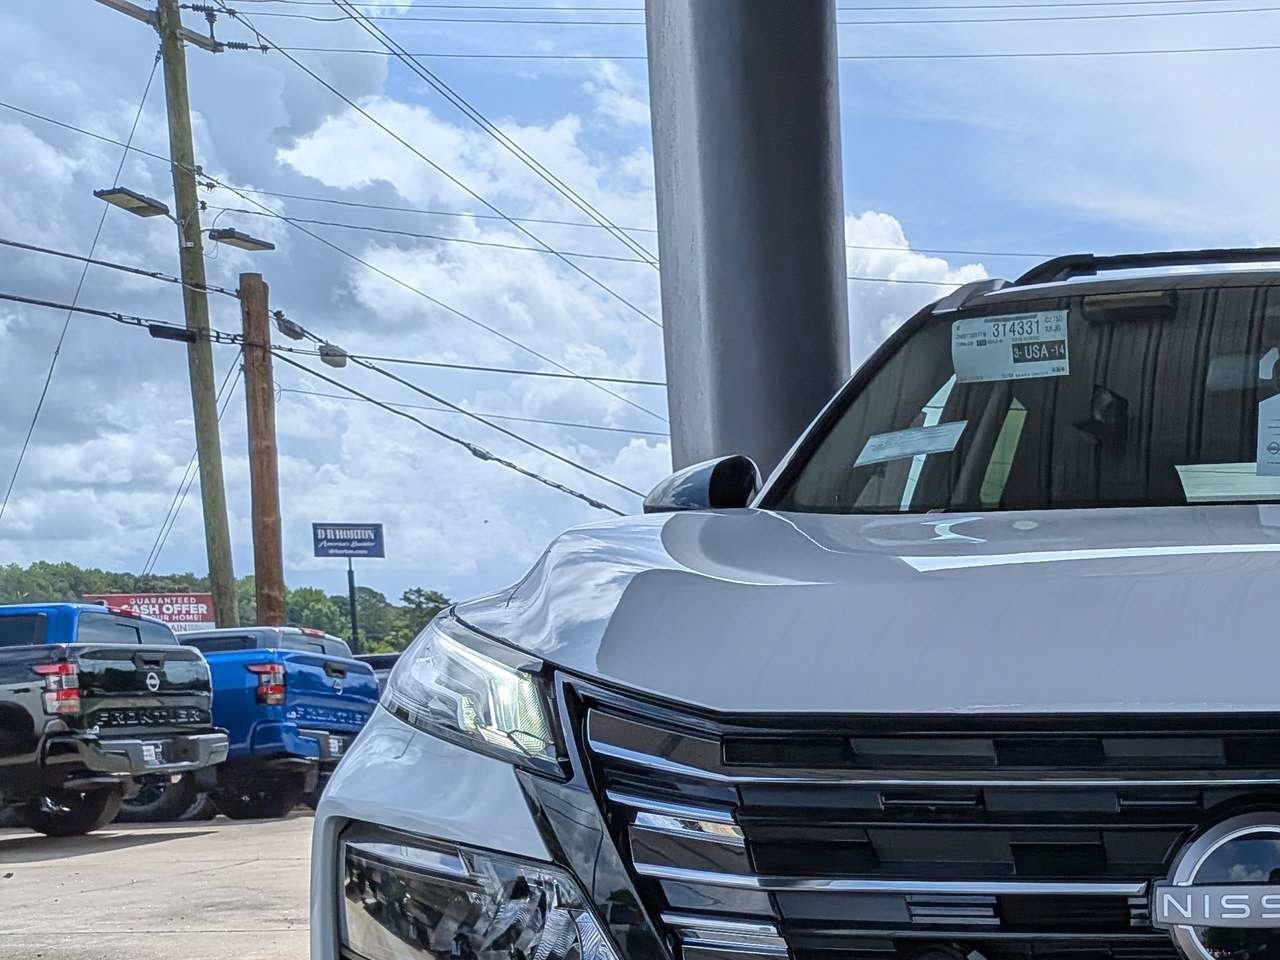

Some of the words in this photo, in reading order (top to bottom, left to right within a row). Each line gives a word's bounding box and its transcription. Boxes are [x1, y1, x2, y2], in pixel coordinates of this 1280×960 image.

[992, 320, 1040, 337] 314331
[1025, 345, 1049, 359] USA
[129, 596, 197, 605] GUARANTEED
[162, 603, 208, 615] OFFER
